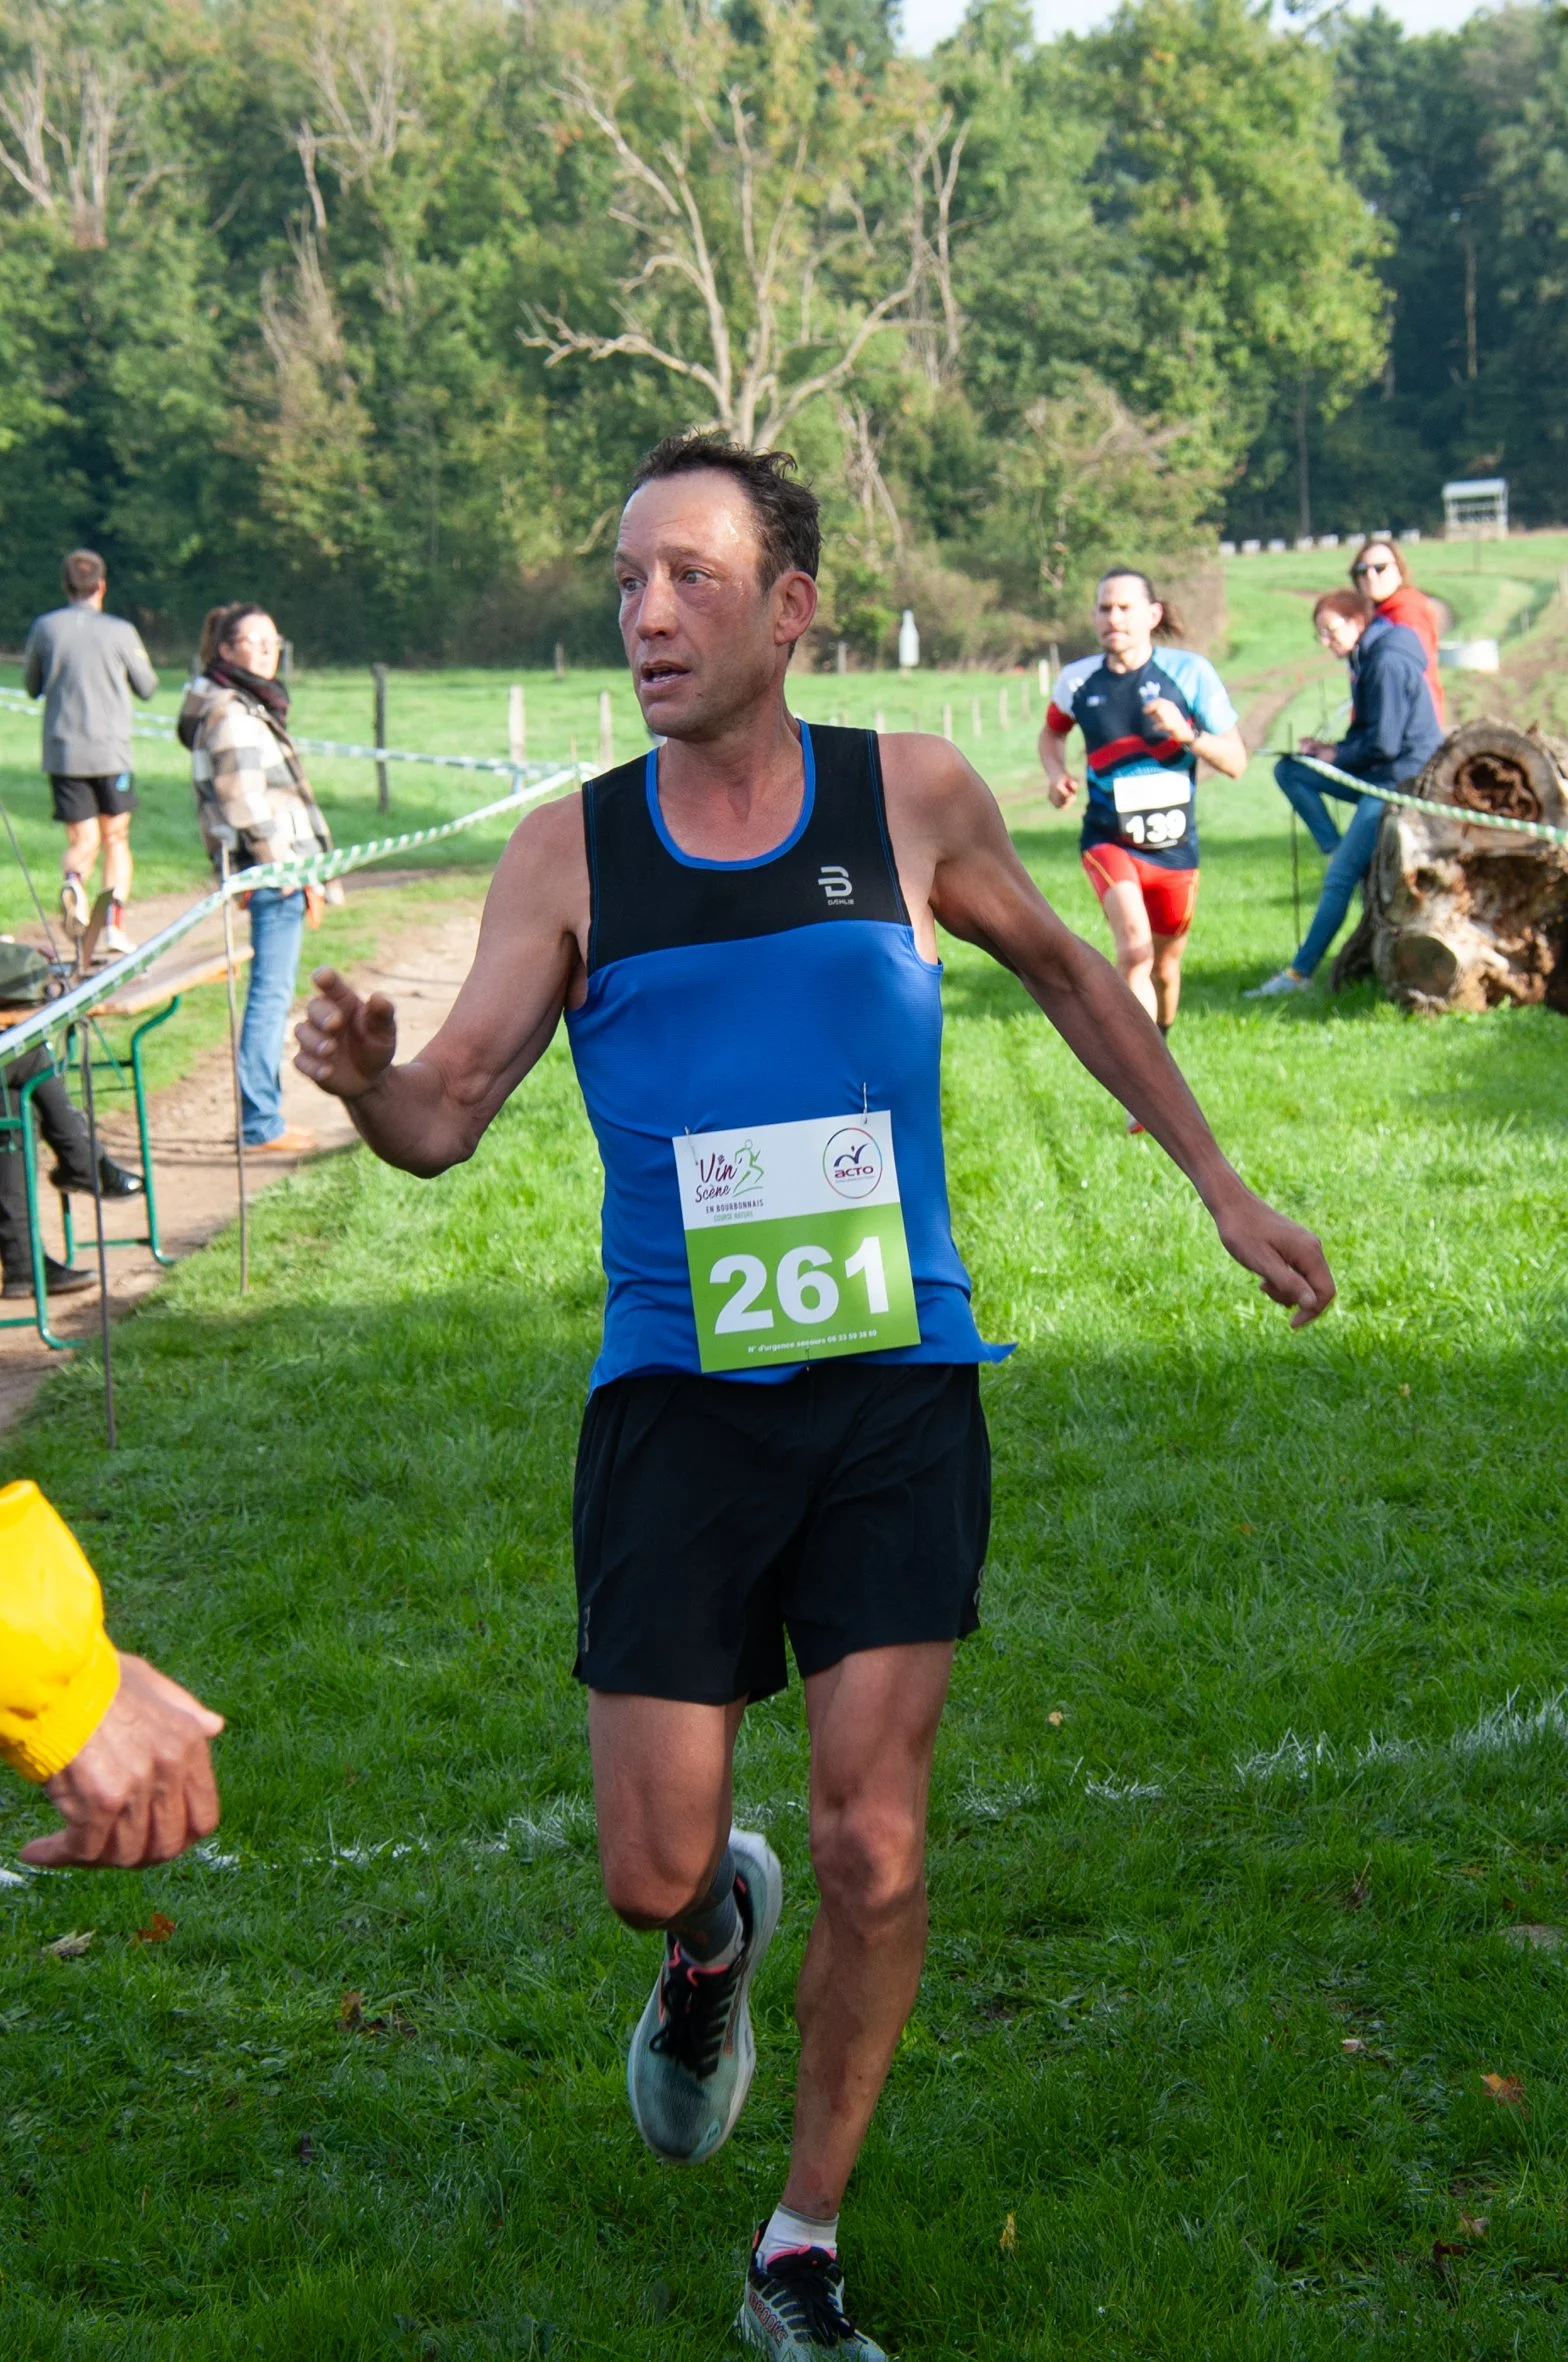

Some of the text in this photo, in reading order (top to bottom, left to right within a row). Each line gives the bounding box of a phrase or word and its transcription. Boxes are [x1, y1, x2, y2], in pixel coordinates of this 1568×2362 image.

[1126, 809, 1186, 844] 139
[706, 1199, 764, 1214] EN BOURBONNAIS
[709, 1236, 889, 1335] 261
[758, 1342, 795, 1352] d'urgence
[796, 1338, 826, 1347] secours
